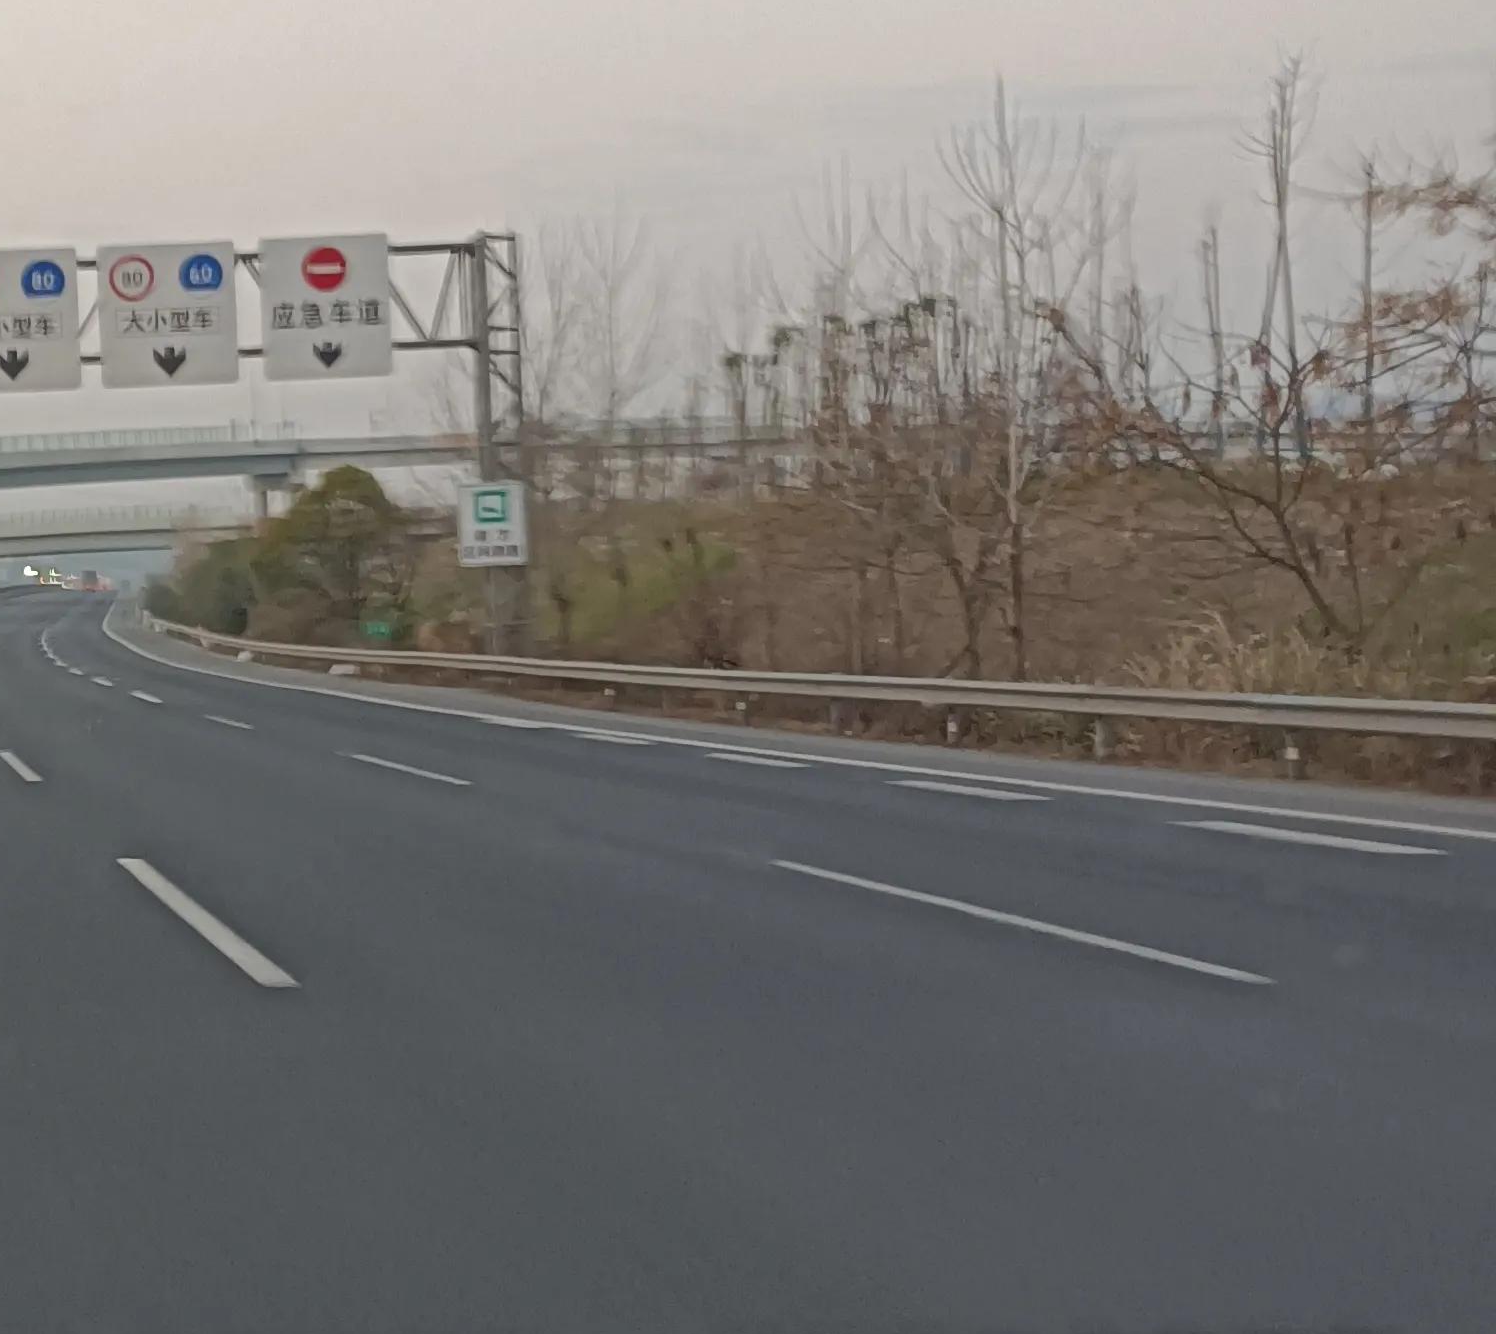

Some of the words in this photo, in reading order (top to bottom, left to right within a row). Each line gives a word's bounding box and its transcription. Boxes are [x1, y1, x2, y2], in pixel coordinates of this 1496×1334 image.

[120, 308, 213, 334] 大小型车
[271, 299, 386, 330] 应急车道
